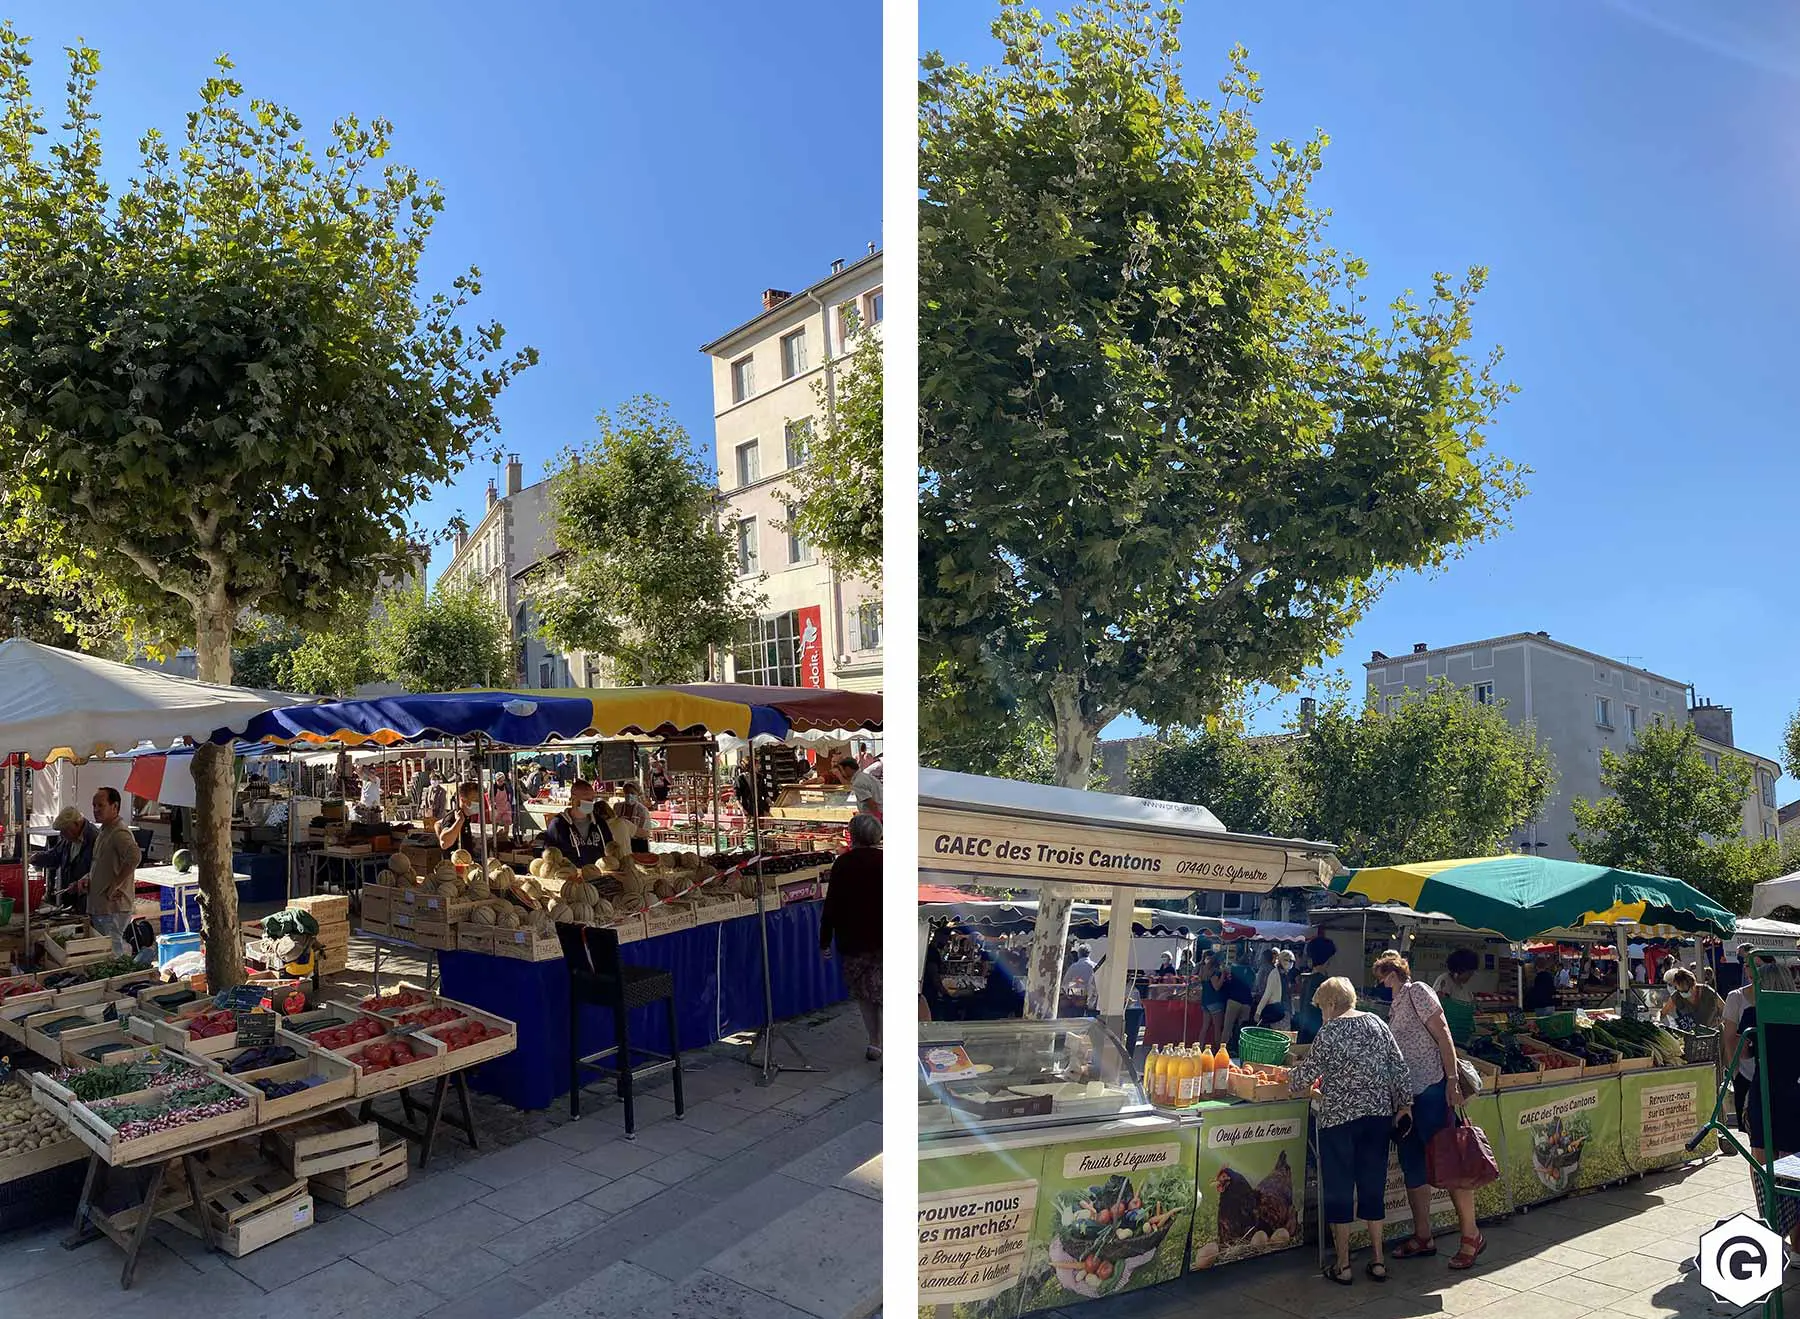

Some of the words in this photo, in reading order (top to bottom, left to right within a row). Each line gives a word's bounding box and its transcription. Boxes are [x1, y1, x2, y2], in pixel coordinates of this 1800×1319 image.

[809, 650, 820, 688] doir.
[935, 834, 992, 857] GAEC
[995, 840, 1032, 861] des
[1037, 844, 1085, 866] Trois
[1088, 849, 1162, 872] Cantons
[1176, 860, 1211, 876] 07440
[1211, 863, 1224, 877] St
[1224, 865, 1268, 884] Sylvestre
[1520, 1111, 1541, 1125] GAEC
[1540, 1109, 1552, 1120] des
[1552, 1103, 1569, 1116] Trois
[1569, 1095, 1596, 1111] Cantons
[1648, 1109, 1659, 1119] sur
[1215, 1127, 1241, 1146] Oeufs
[1242, 1126, 1254, 1139] de
[1254, 1125, 1266, 1138] la
[1265, 1123, 1292, 1137] Ferme
[1079, 1155, 1112, 1172] Fruits
[1113, 1152, 1124, 1168] &
[1123, 1151, 1167, 1172] Légumes
[918, 1197, 1020, 1223] rouvez-nous
[918, 1228, 940, 1244] es
[920, 1271, 968, 1289] samedi
[970, 1271, 980, 1284] à
